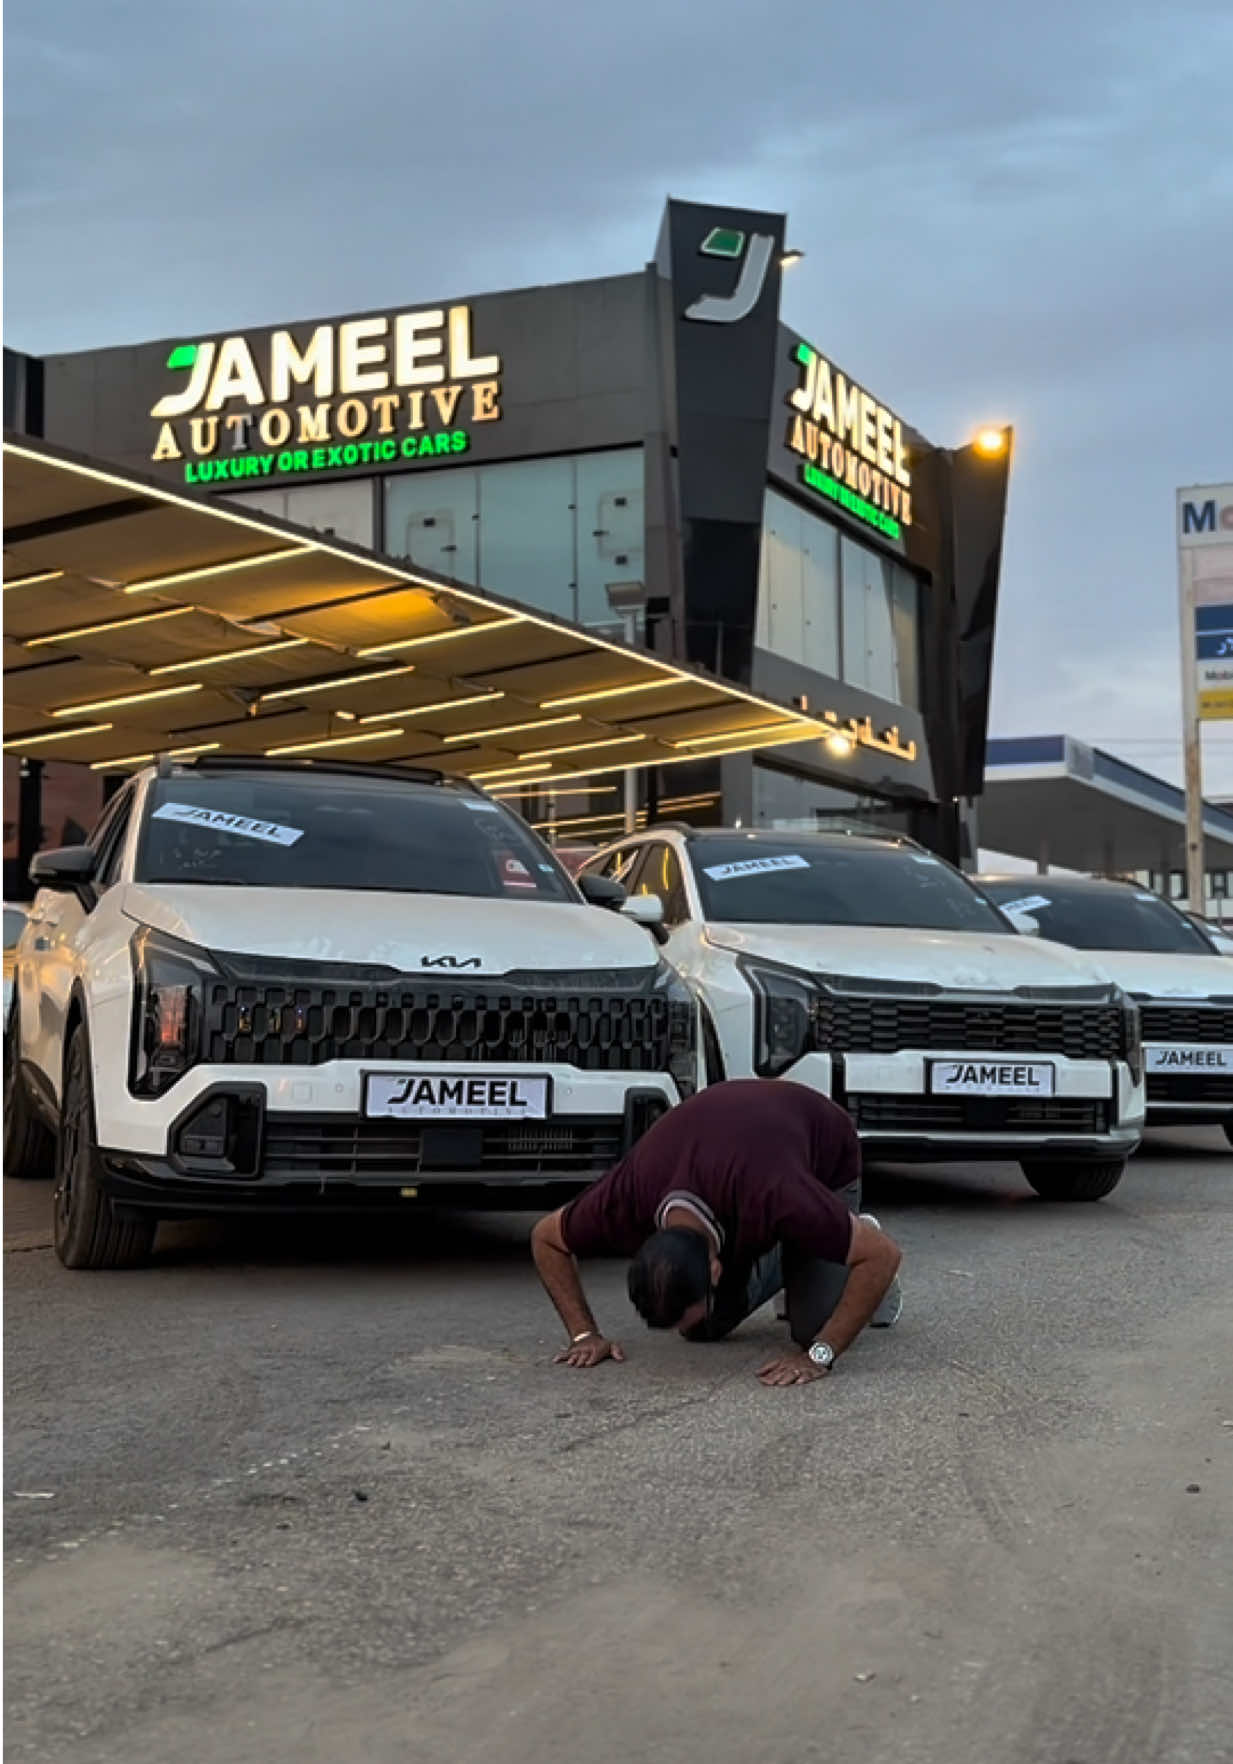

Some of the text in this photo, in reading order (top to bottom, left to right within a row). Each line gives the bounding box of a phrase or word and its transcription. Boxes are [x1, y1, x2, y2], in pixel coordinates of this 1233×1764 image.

[150, 305, 499, 417] JAMEEL
[152, 381, 499, 460] AUTOMOTIVE
[791, 343, 910, 487] JAMEEL
[185, 431, 467, 482] LUXURY OR EXOTIC CARS
[791, 415, 912, 525] AUTOMOTIVE
[176, 809, 280, 838] JAMEEL
[946, 1064, 1040, 1086] JAMEEL
[1156, 1050, 1228, 1066] JAMEEL
[387, 1078, 528, 1106] JAMEEL
